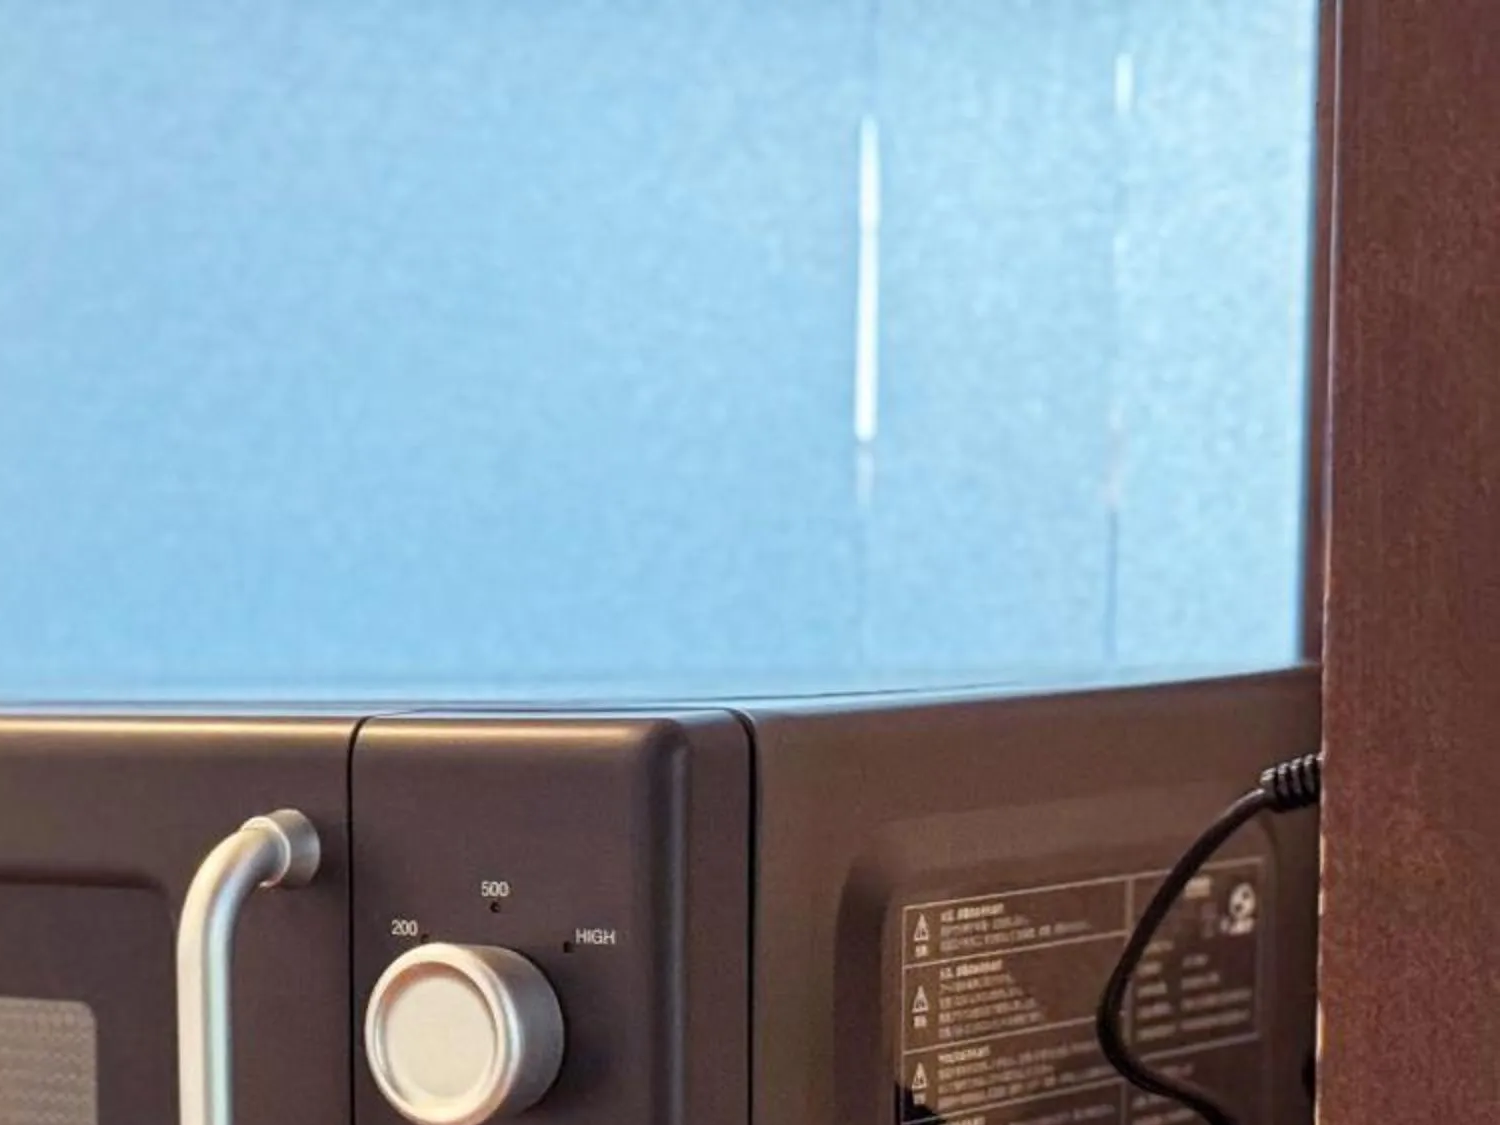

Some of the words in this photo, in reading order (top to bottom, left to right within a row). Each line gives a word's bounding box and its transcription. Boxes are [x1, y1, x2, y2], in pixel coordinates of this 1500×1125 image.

[481, 880, 509, 897] 500
[391, 919, 418, 936] 200
[575, 928, 616, 945] HIGH
